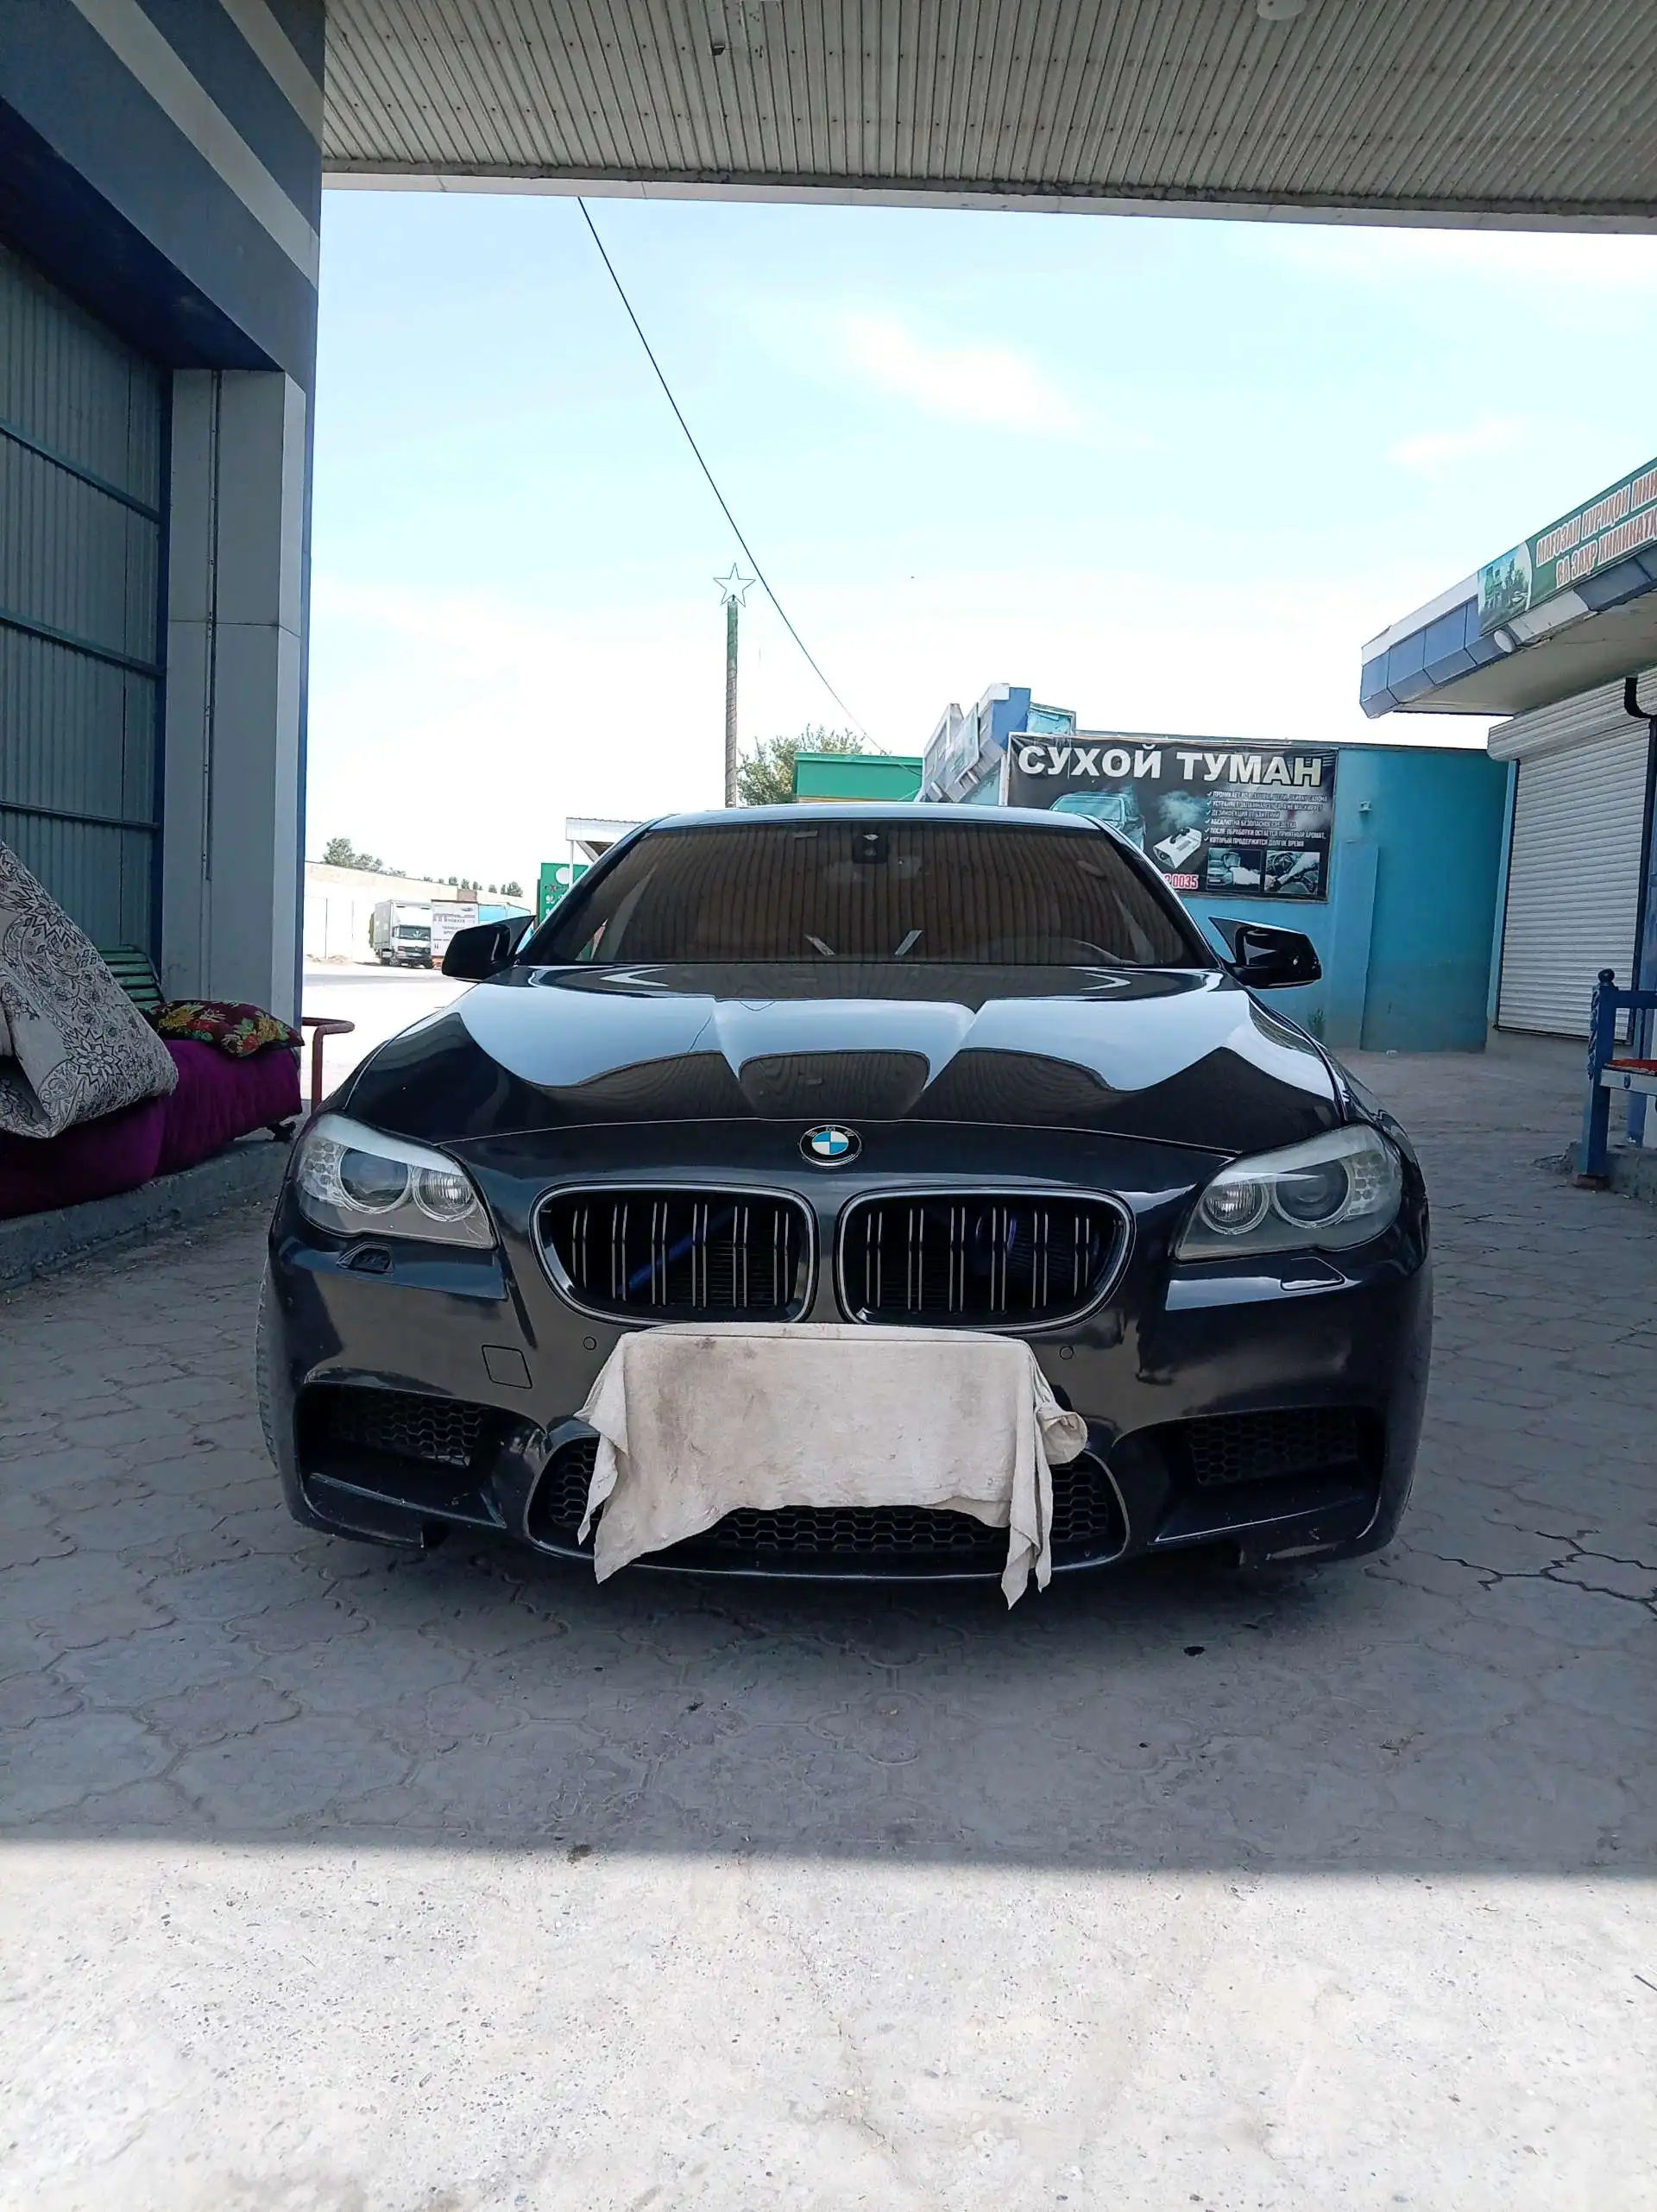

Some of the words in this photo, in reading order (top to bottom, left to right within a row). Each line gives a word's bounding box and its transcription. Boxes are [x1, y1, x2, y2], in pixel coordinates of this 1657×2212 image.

[1556, 555, 1570, 589] ВА
[1018, 744, 1162, 778] СУХОЙ
[1176, 752, 1321, 786] ТУМАН
